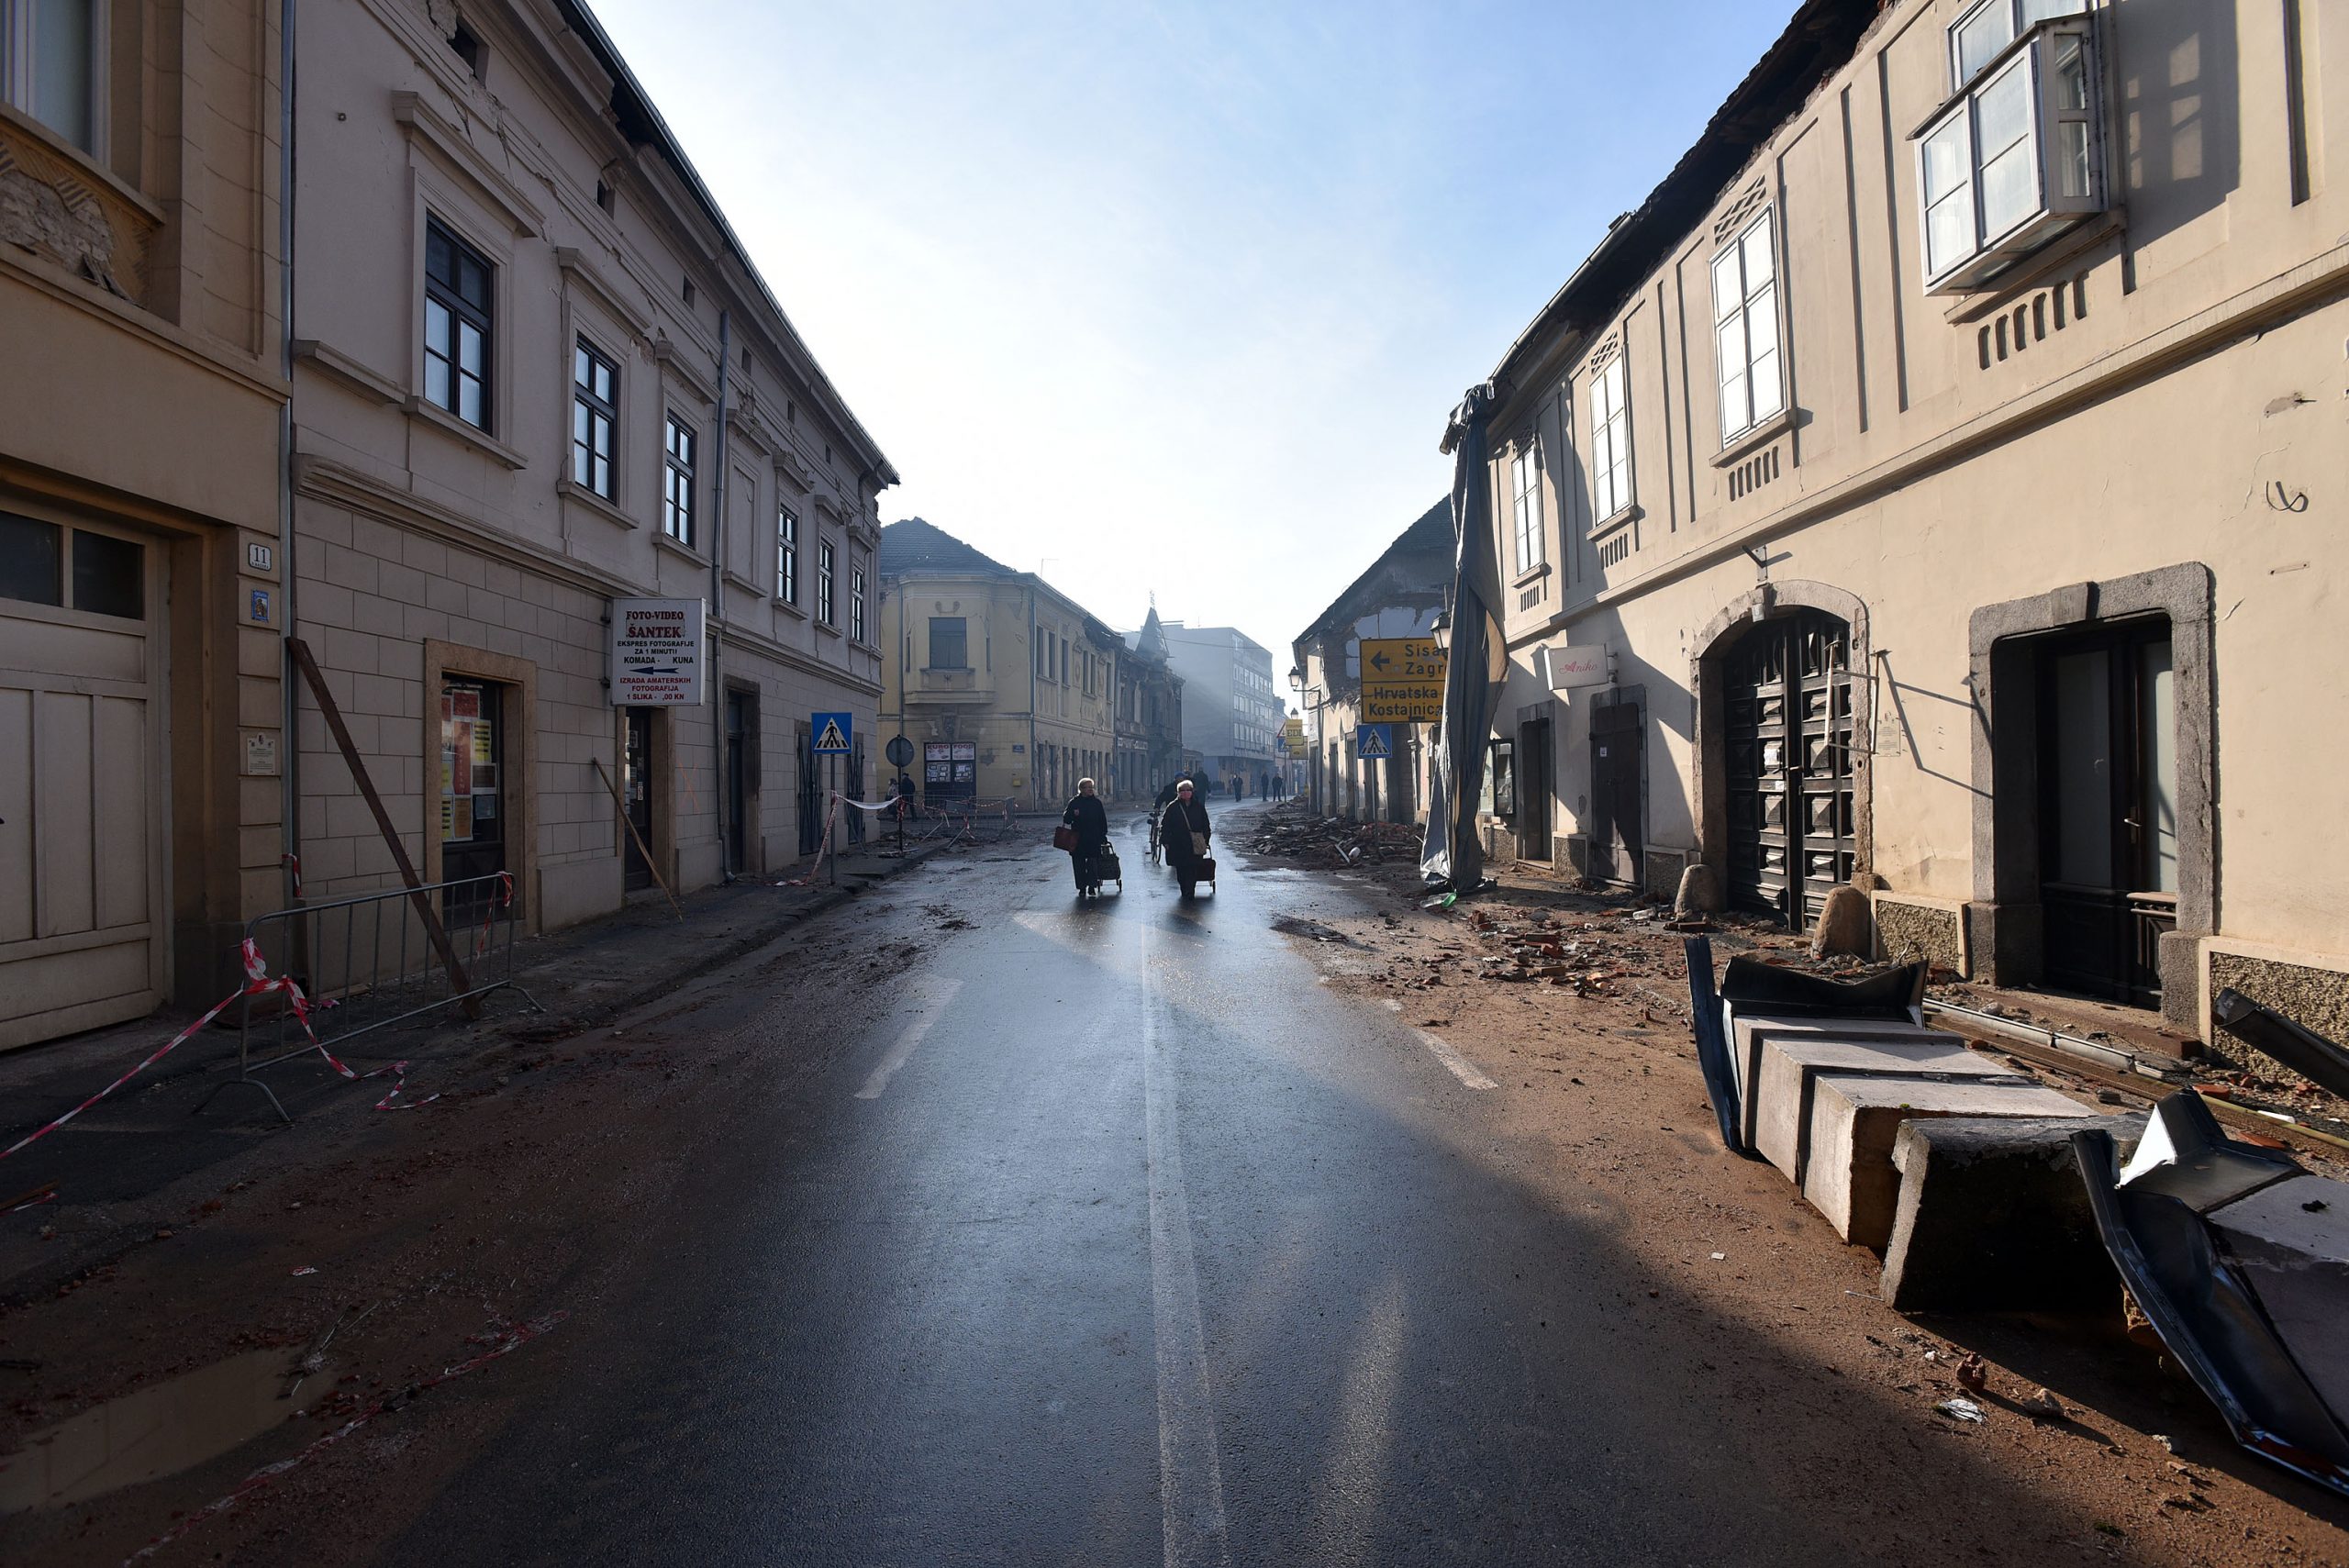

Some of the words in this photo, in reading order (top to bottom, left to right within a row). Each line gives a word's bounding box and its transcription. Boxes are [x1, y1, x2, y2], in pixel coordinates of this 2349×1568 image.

[253, 547, 266, 563] 11
[626, 611, 684, 620] FOTO-VIDEO
[628, 623, 682, 638] ŠANTEK
[1405, 644, 1447, 658] Sisa
[624, 656, 655, 664] KOMADA
[673, 656, 694, 664] KUNA
[1405, 662, 1446, 677] Zagr
[1374, 686, 1438, 700] Hrvatska
[1369, 703, 1443, 717] Kostajnica
